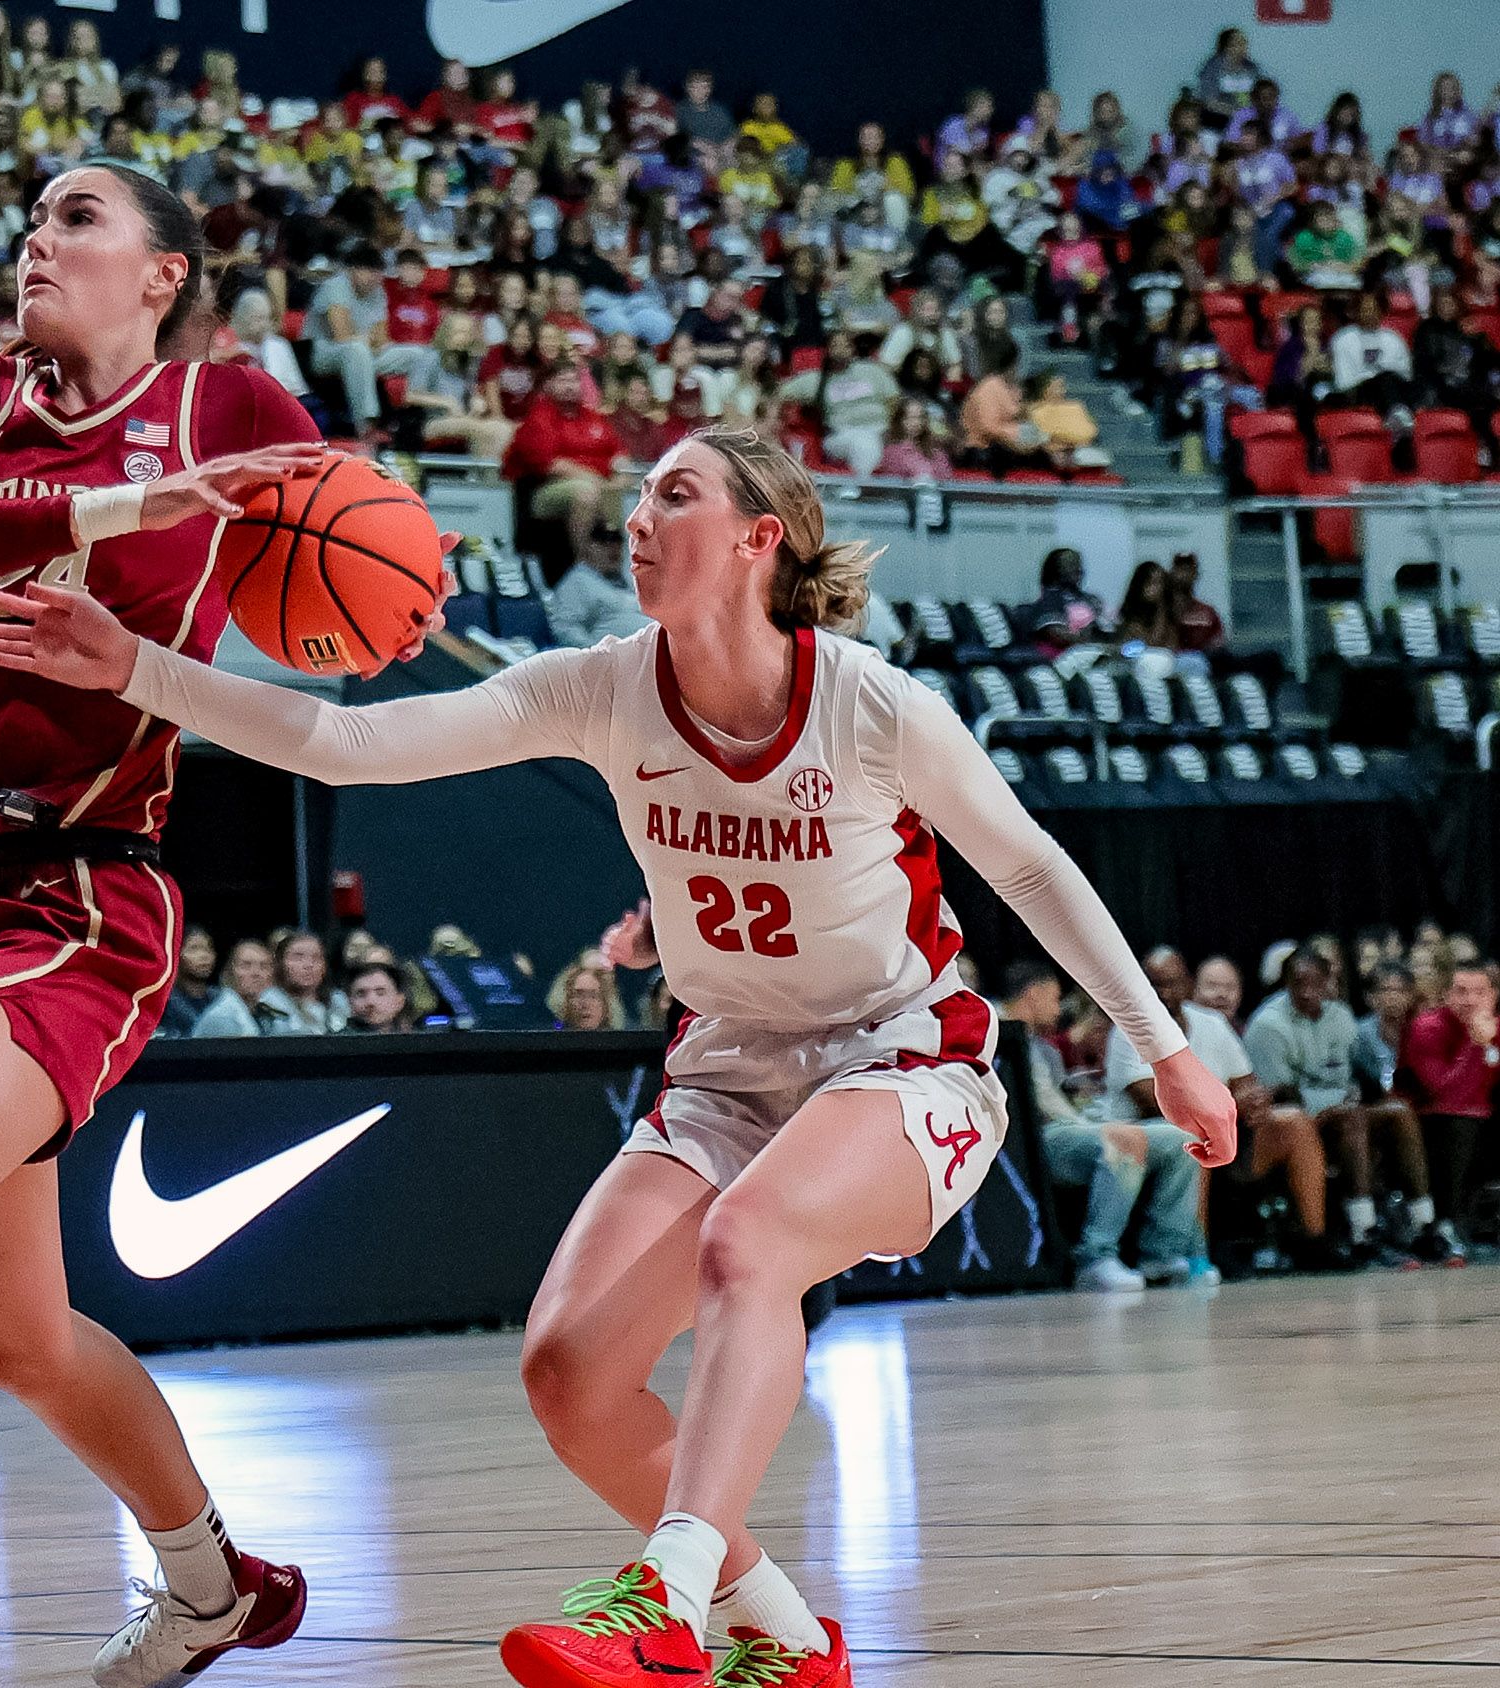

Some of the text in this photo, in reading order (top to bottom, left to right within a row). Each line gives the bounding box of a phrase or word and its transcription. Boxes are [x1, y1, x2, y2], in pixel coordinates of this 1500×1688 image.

[789, 769, 833, 810] SEC
[646, 803, 833, 862] ALABAMA
[687, 875, 799, 958] 22
